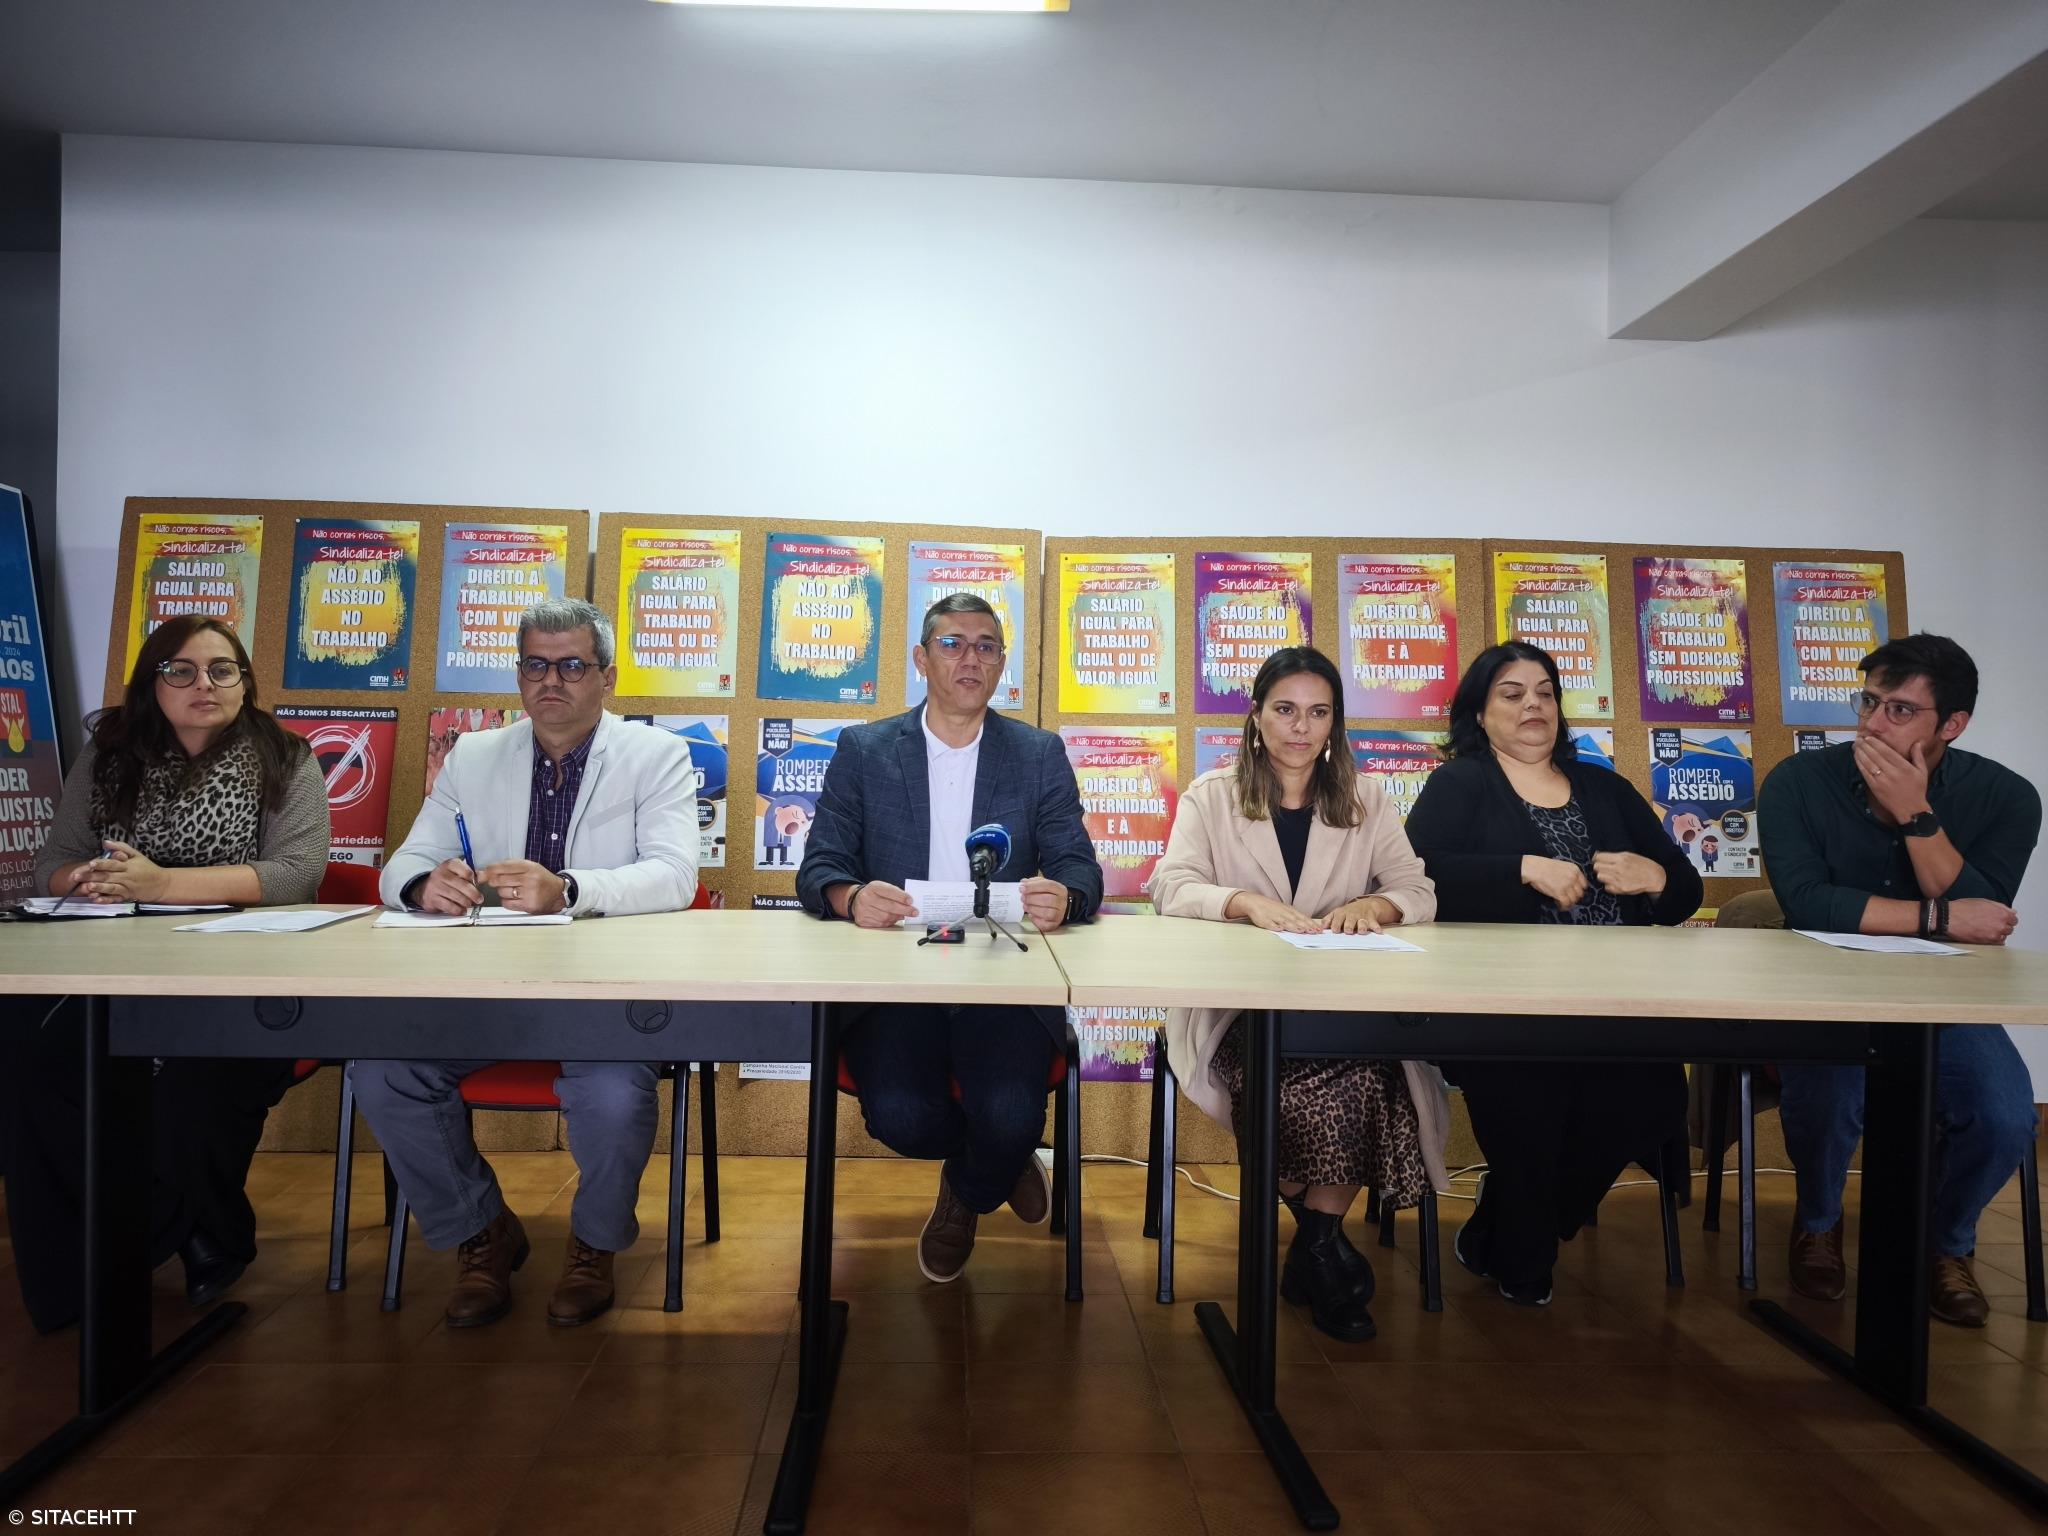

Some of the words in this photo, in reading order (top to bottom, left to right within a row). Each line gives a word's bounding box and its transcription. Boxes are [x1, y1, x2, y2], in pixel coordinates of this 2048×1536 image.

[312, 530, 328, 538] Não
[330, 531, 356, 539] corras
[462, 532, 476, 540] Não
[480, 532, 506, 540] corras
[162, 541, 246, 554] Sindicaliza-te!
[320, 546, 404, 560] Sindicaliza-te!
[783, 544, 797, 552] Não
[800, 545, 824, 554] corras
[942, 551, 966, 559] corras
[469, 549, 556, 562] Sindicaliza-te!
[644, 556, 725, 568] Sindicaliza-te!
[168, 560, 226, 576] SALÁRIO
[790, 561, 870, 575] Sindicaliza-te!
[932, 567, 1014, 581] Sindicaliza-te!
[1210, 563, 1224, 571] Não
[1355, 565, 1368, 573] Não
[1789, 570, 1802, 578] Não
[328, 566, 358, 583] NÃO
[362, 569, 383, 584] AO
[468, 569, 524, 584] DIREITO
[529, 570, 539, 585] A
[652, 574, 707, 591] SALÁRIO
[155, 581, 194, 596] IGUAL
[199, 582, 235, 596] PARA
[799, 580, 827, 598] NÃO
[832, 584, 850, 599] AO
[1084, 579, 1160, 590] Sindicaliza-te!
[1218, 579, 1298, 590] Sindicaliza-te!
[1363, 581, 1440, 592] Sindicaliza-te!
[1518, 580, 1593, 591] Sindicaliza-te!
[1657, 585, 1734, 596] Sindicaliza-te!
[322, 587, 385, 605] ASSÉDIO
[461, 589, 544, 604] TRABALHAR
[991, 588, 999, 603] A
[1798, 587, 1877, 600] Sindicaliza-te!
[158, 601, 228, 616] TRABALHO
[640, 594, 678, 609] IGUAL
[683, 595, 716, 610] PARA
[793, 601, 853, 618] ASSÉDIO
[1091, 596, 1143, 612] SALÁRIO
[1527, 597, 1578, 614] SALÁRIO
[341, 610, 362, 625] NO
[465, 611, 497, 626] COM
[1220, 604, 1264, 620] SAÚDE
[1268, 607, 1286, 620] NO
[1364, 604, 1417, 619] DIREITO
[1423, 603, 1432, 619] À
[1660, 610, 1703, 626] SAÚDE
[1706, 614, 1723, 627] NO
[1800, 607, 1850, 621] DIREITO
[1856, 608, 1864, 622] A
[644, 614, 711, 628] TRABALHO
[1081, 617, 1116, 629] IGUAL
[1122, 617, 1154, 630] PARA
[1518, 618, 1553, 632] IGUAL
[1558, 619, 1589, 632] PARA
[811, 624, 832, 638] NO
[1219, 625, 1288, 639] TRABALHO
[1350, 624, 1446, 639] MATERNIDADE
[1794, 626, 1871, 641] TRABALHAR
[312, 631, 387, 647] TRABALHO
[462, 631, 518, 647] PESSOA
[637, 633, 674, 647] IGUAL
[679, 634, 696, 647] OU
[702, 634, 718, 648] DE
[1085, 635, 1149, 648] TRABALHO
[1660, 632, 1726, 647] TRABALHO
[784, 643, 856, 660] TRABALHO
[1207, 644, 1234, 657] SEM
[1388, 645, 1395, 659] E
[1400, 642, 1409, 659] À
[1801, 646, 1831, 661] COM
[635, 652, 675, 666] VALOR
[680, 653, 718, 667] IGUAL
[1078, 653, 1114, 666] IGUAL
[1119, 653, 1136, 666] OU
[1141, 654, 1156, 666] DE
[1557, 656, 1573, 669] OU
[1578, 657, 1593, 670] DE
[1650, 651, 1675, 665] SEM
[1680, 652, 1739, 668] DOENÇAS
[1076, 671, 1115, 684] VALOR
[1121, 672, 1158, 684] IGUAL
[1353, 665, 1445, 680] PATERNIDADE
[1647, 670, 1744, 685] PROFISSIONAIS
[1802, 666, 1858, 681] PESSOAL
[276, 708, 295, 716] NÃO
[298, 709, 328, 717] SOMOS
[768, 738, 788, 749] NÃO!
[1359, 741, 1372, 749] Não
[1084, 753, 1161, 766] Sindicaliza-te!
[1660, 748, 1678, 758] NÃO!
[1669, 768, 1720, 783] ROMPER
[1084, 778, 1137, 792] DIREITO
[1144, 776, 1152, 792] À
[1668, 780, 1734, 801] ASSÉDIO
[1108, 819, 1114, 834] E
[1119, 817, 1128, 834] À
[755, 898, 773, 906] NÃO
[1071, 1007, 1097, 1018] SEM
